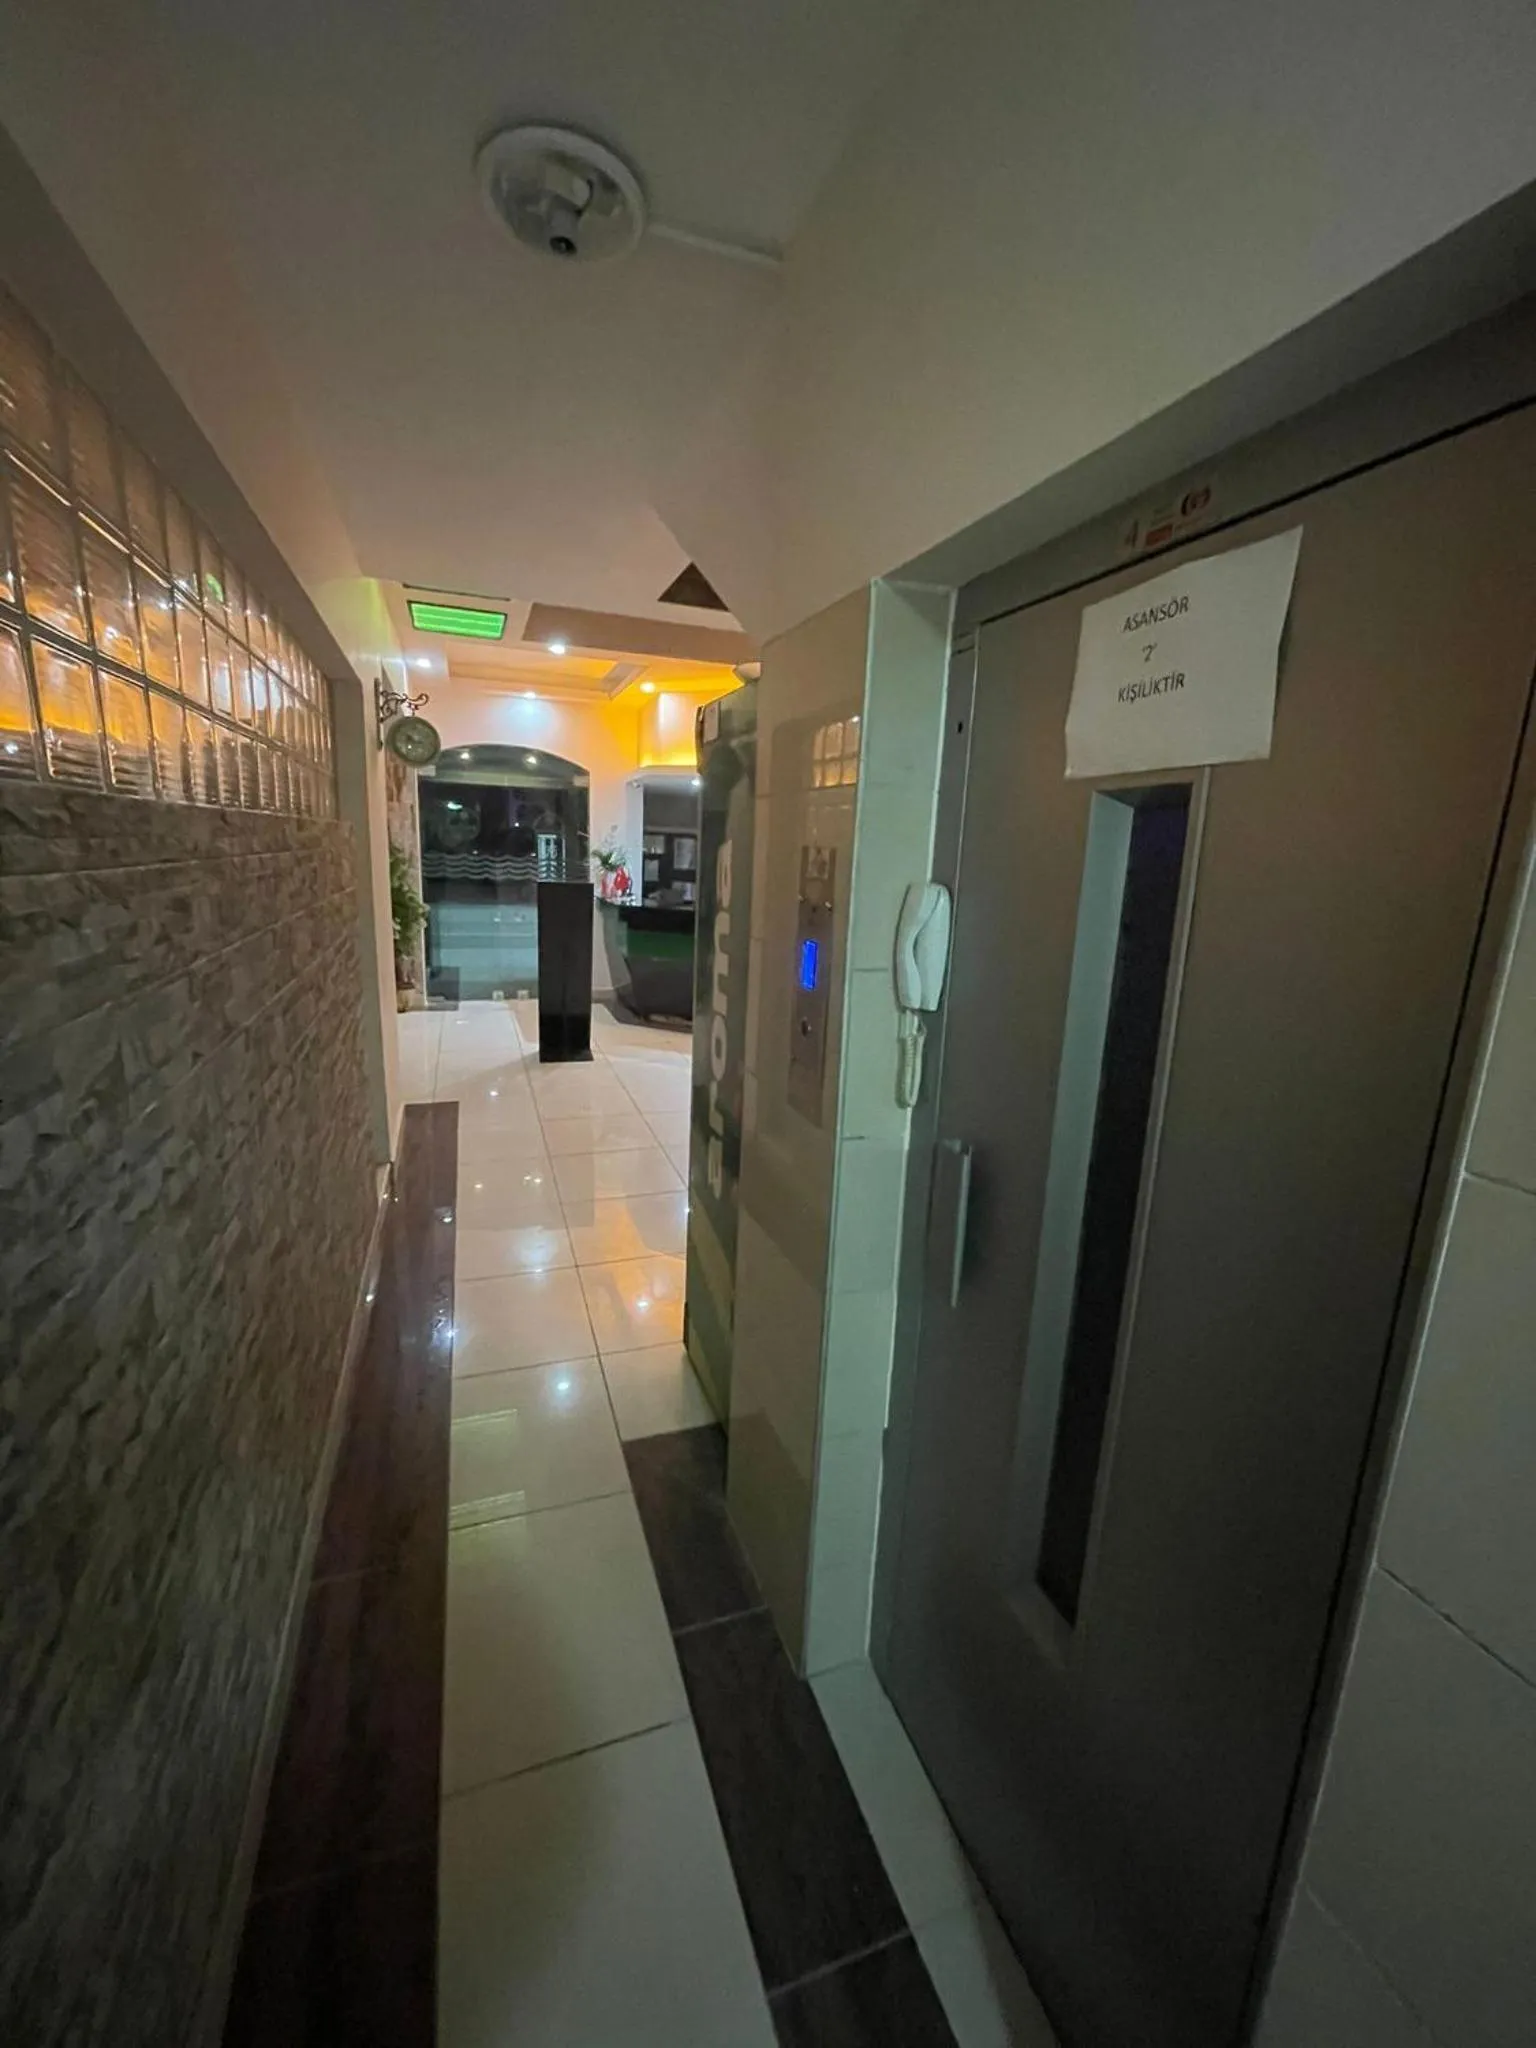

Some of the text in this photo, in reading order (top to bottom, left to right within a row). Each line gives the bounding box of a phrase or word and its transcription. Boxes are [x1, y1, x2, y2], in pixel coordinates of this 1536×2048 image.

[1122, 595, 1189, 633] ASANSÖR
[1118, 671, 1186, 703] KİŞİLİKTİR
[708, 841, 732, 1199] aroma
